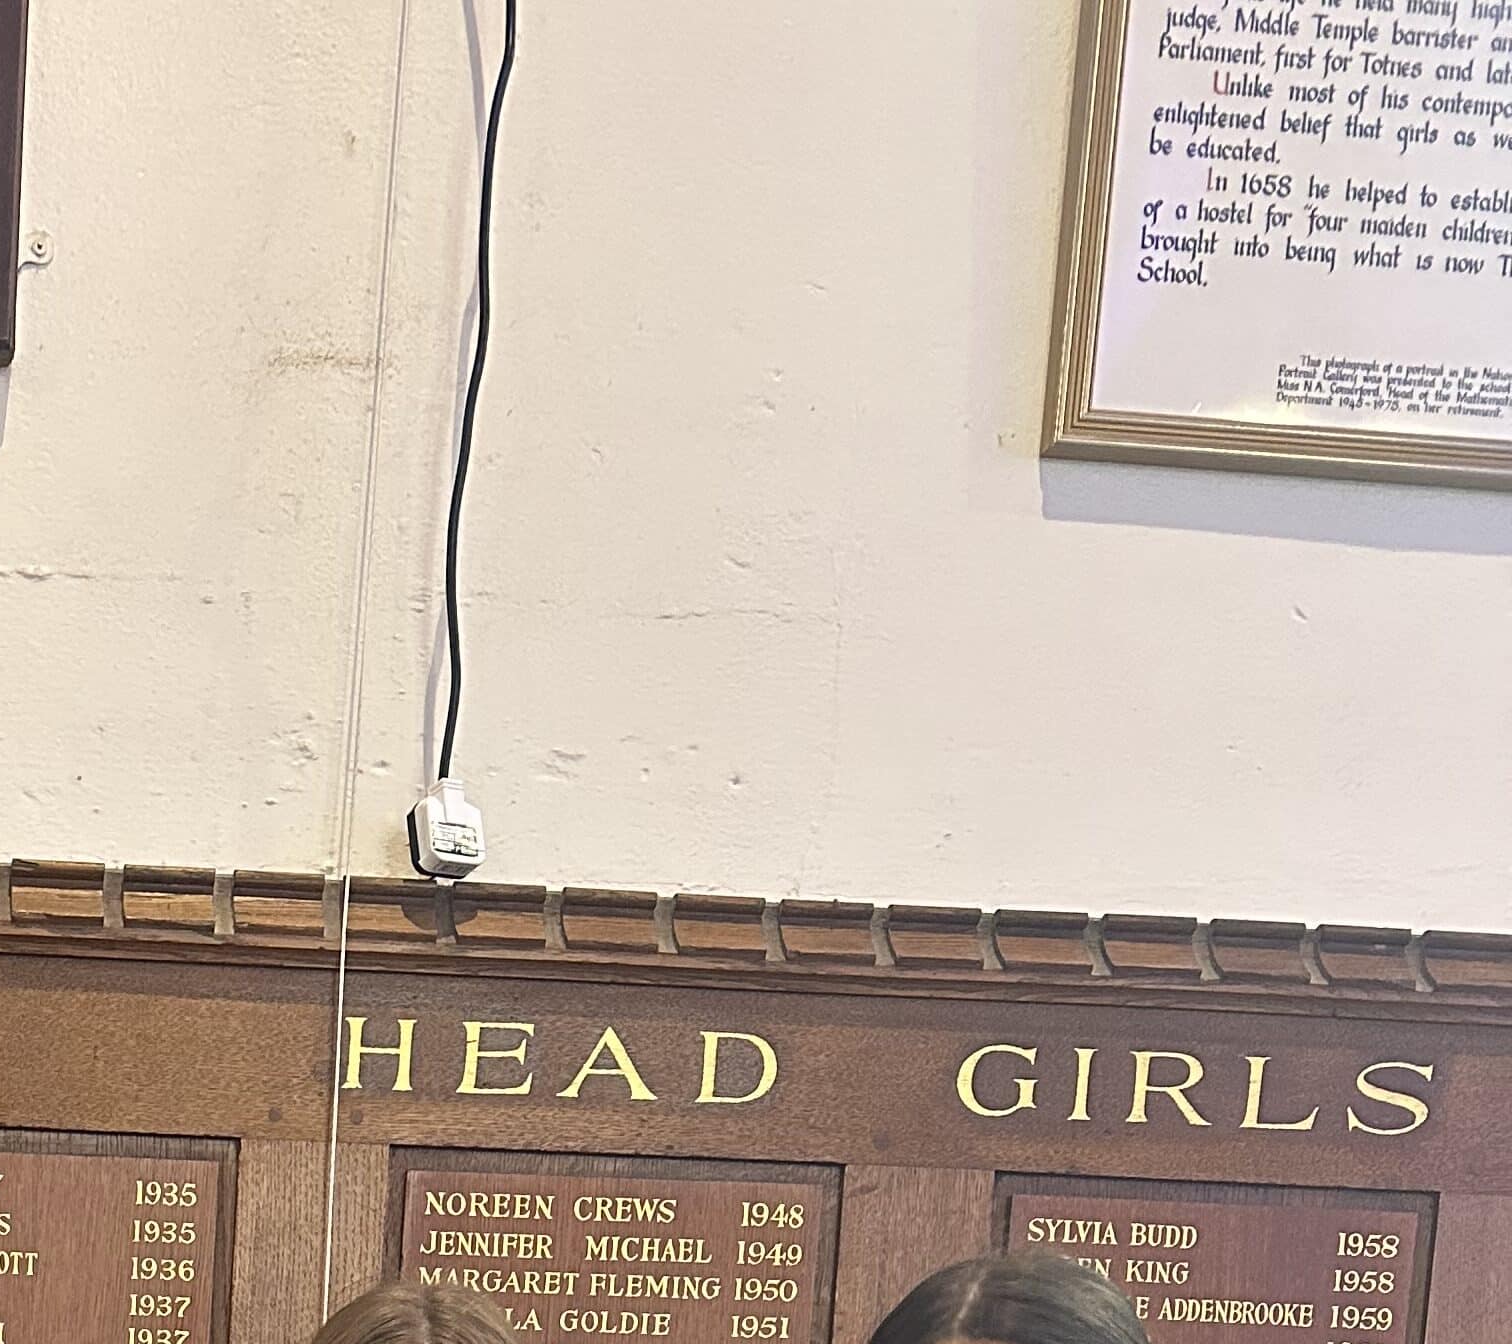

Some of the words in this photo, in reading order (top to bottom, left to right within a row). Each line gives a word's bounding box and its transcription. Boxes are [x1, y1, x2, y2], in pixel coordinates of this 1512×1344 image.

[1166, 6, 1221, 39] judge,
[1235, 4, 1299, 36] Middle
[1312, 14, 1378, 51] Temple
[1392, 20, 1478, 49] barrister
[1214, 71, 1272, 98] Unlike
[1289, 84, 1335, 103] most
[1348, 85, 1369, 114] of
[1381, 85, 1408, 110] his
[1150, 126, 1172, 155] be
[1187, 136, 1280, 164] educated.
[1154, 102, 1266, 135] enlightened
[1281, 109, 1332, 144] belief
[1345, 114, 1382, 139] that
[1397, 121, 1438, 155] girls
[1454, 131, 1476, 147] as
[1207, 167, 1227, 191] In
[1241, 173, 1291, 198] 1658
[1309, 175, 1329, 199] he
[1346, 179, 1408, 212] helped
[1421, 185, 1437, 207] to
[1138, 256, 1207, 286] School.
[341, 1017, 777, 1103] HEAD
[957, 1045, 1433, 1135] GIRLS
[136, 1181, 196, 1206] 1935
[425, 1192, 554, 1219] NOREEN
[574, 1197, 676, 1223] CREWS
[741, 1202, 803, 1228] 1948
[133, 1220, 195, 1244] 1935
[420, 1231, 553, 1258] JENNIFER
[585, 1236, 712, 1263] MICHAEL
[737, 1241, 802, 1266] 1949
[1028, 1218, 1117, 1244] SYLVIA
[1130, 1223, 1197, 1248] BUDD
[1338, 1233, 1399, 1258] 1958
[131, 1257, 194, 1281] 1936
[1126, 1260, 1189, 1284] KING
[1334, 1270, 1394, 1293] 1958
[590, 1274, 721, 1299] FLEMING
[735, 1278, 797, 1302] 1950
[560, 1310, 670, 1335] GOLDIE
[731, 1316, 788, 1338] 1951
[1158, 1298, 1313, 1327] ADDENBROOKE
[1331, 1306, 1392, 1330] 1959
